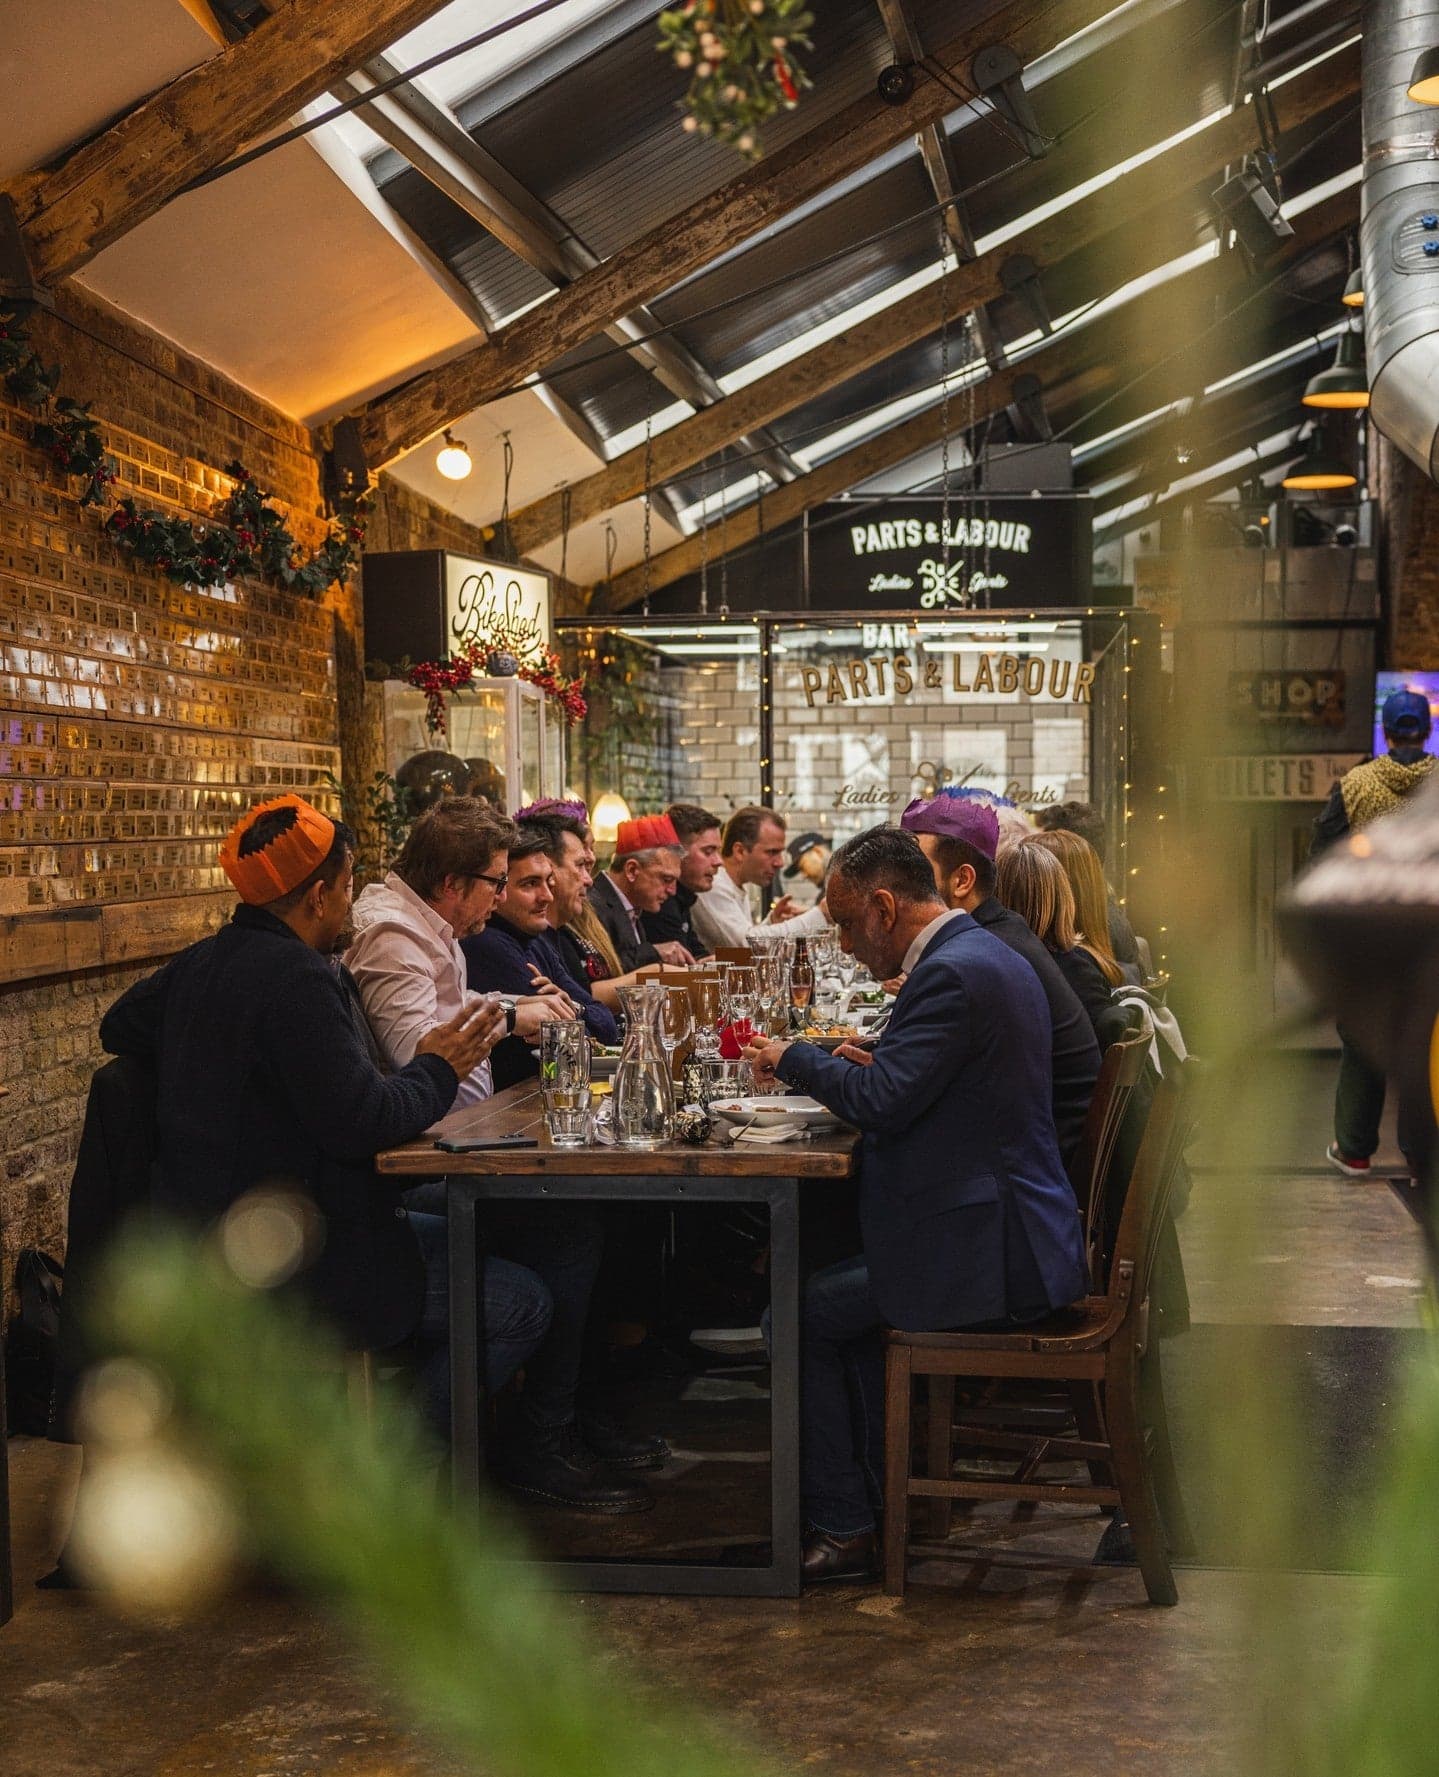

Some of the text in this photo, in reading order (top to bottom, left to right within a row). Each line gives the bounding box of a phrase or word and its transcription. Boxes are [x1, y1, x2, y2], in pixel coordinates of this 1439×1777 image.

[851, 518, 1031, 555] PARTS & LABOUR
[801, 653, 1096, 707] PARTS & LABOUR
[1237, 680, 1336, 706] SHOP
[832, 784, 899, 808] Ladies
